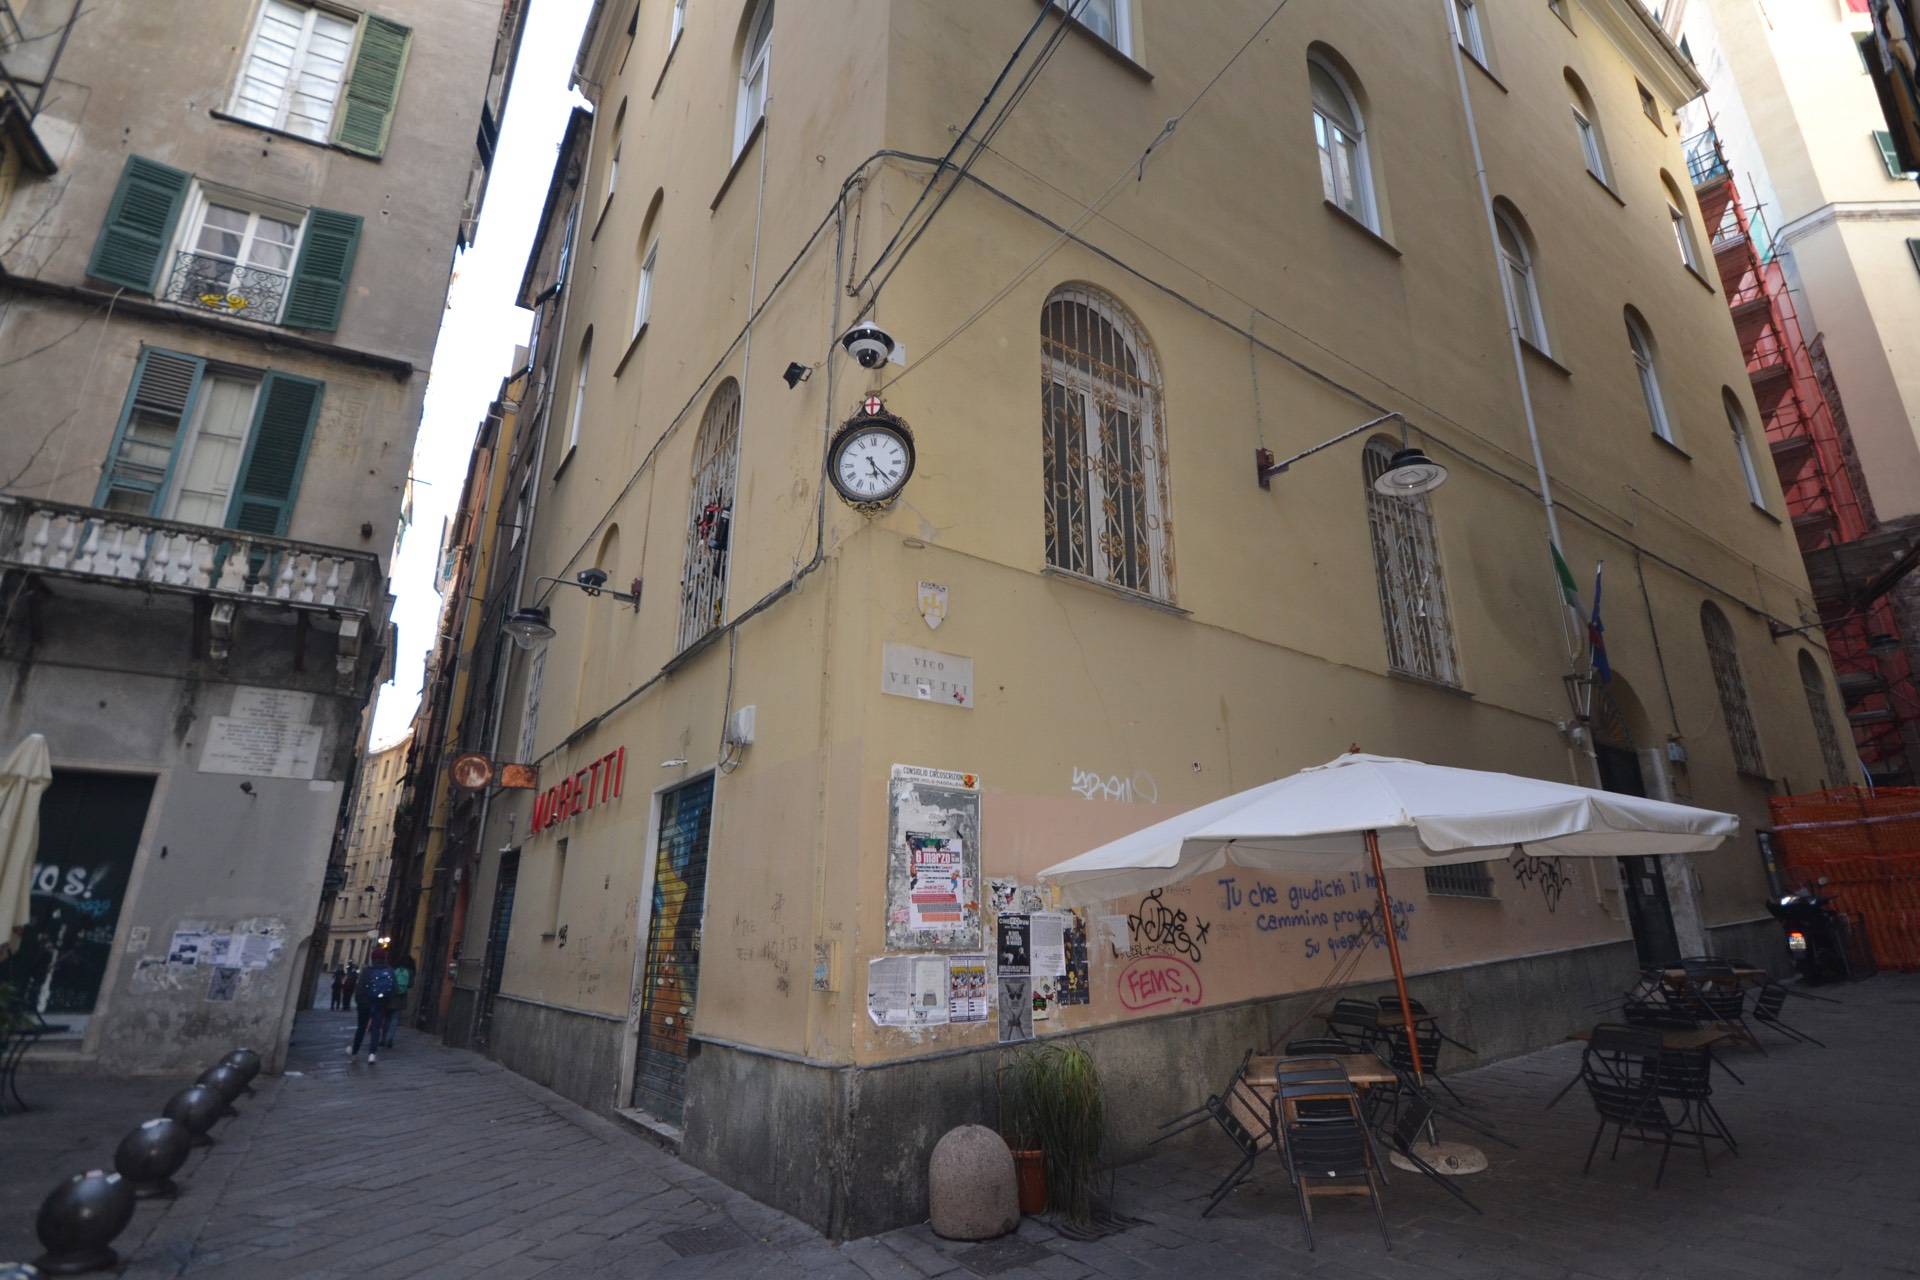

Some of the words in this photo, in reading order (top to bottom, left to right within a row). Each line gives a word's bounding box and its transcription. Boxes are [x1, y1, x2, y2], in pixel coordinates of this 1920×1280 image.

[532, 745, 625, 833] MORETTI
[1249, 882, 1277, 907] che
[1289, 878, 1346, 910] giudichi
[1351, 871, 1360, 893] il
[1257, 909, 1329, 931] cammino
